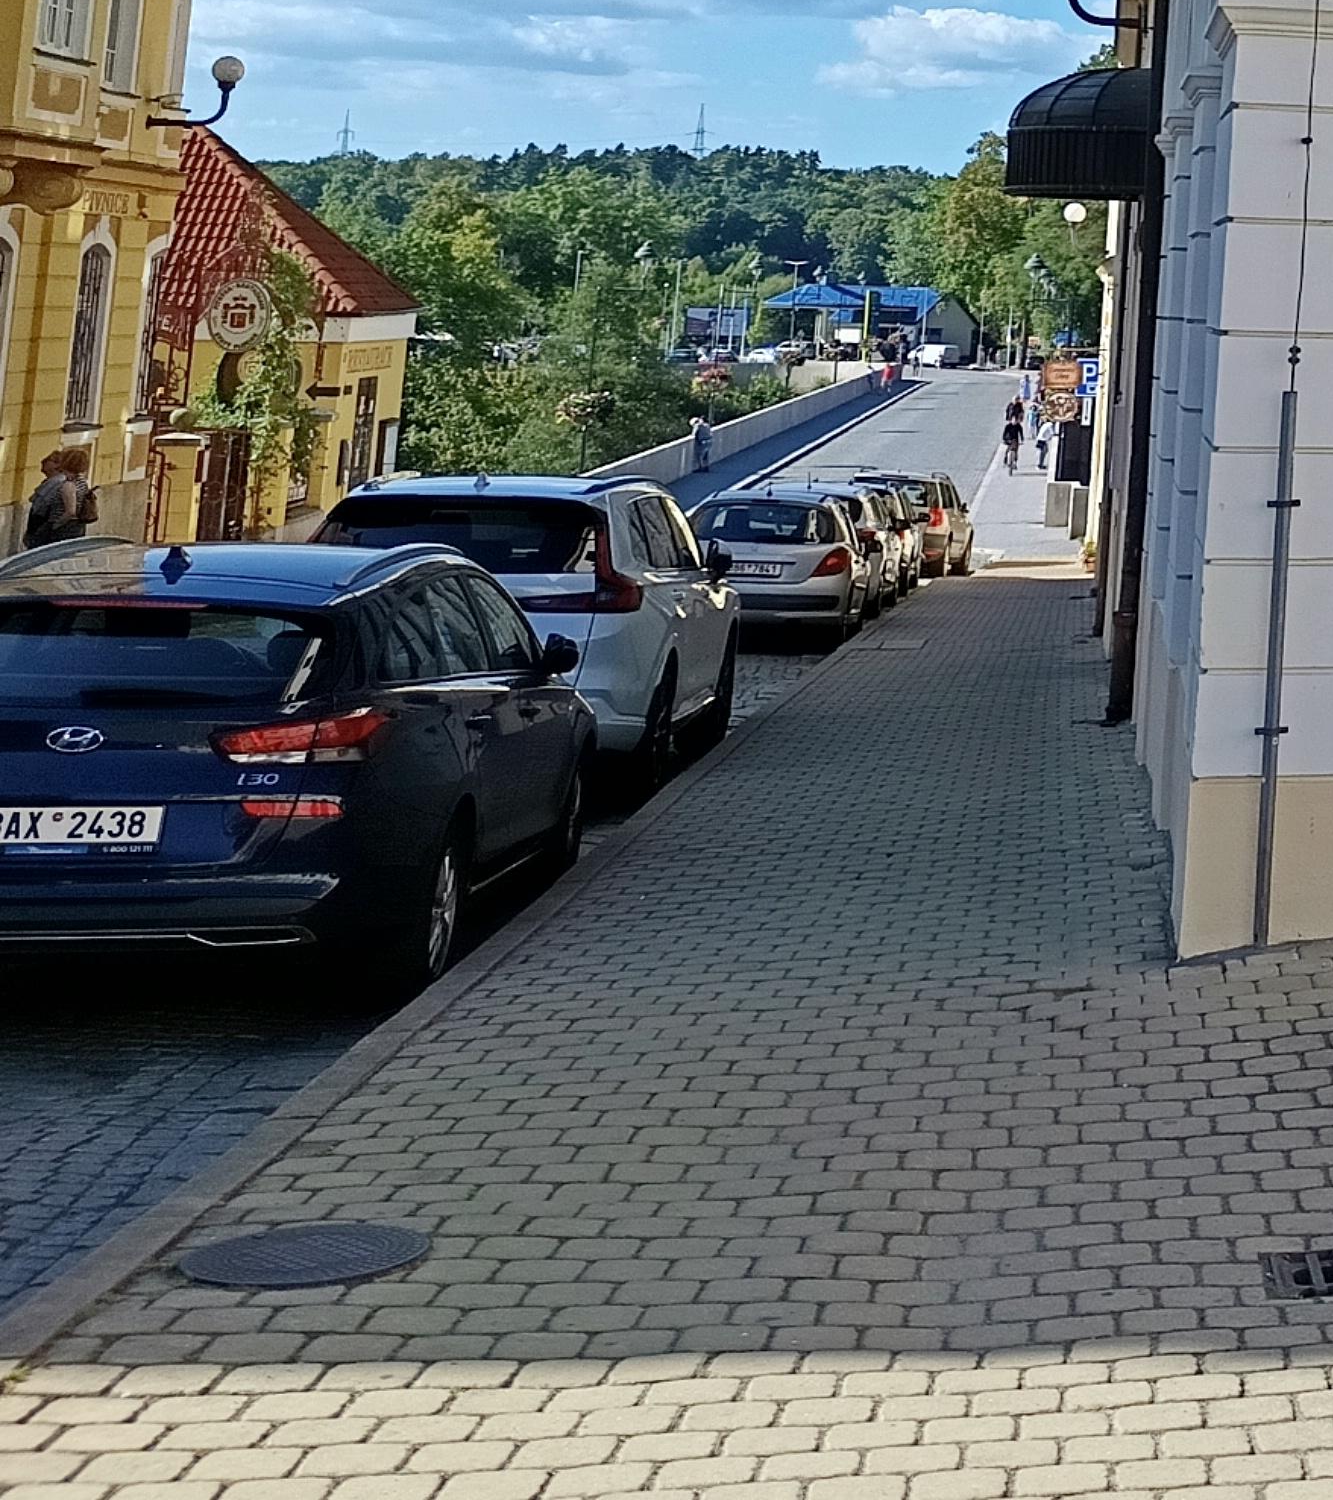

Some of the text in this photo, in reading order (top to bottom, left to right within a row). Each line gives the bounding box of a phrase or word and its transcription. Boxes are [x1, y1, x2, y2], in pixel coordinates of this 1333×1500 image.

[81, 189, 130, 215] PIVNICE
[1082, 363, 1098, 385] P
[0, 810, 147, 840] AX 2438
